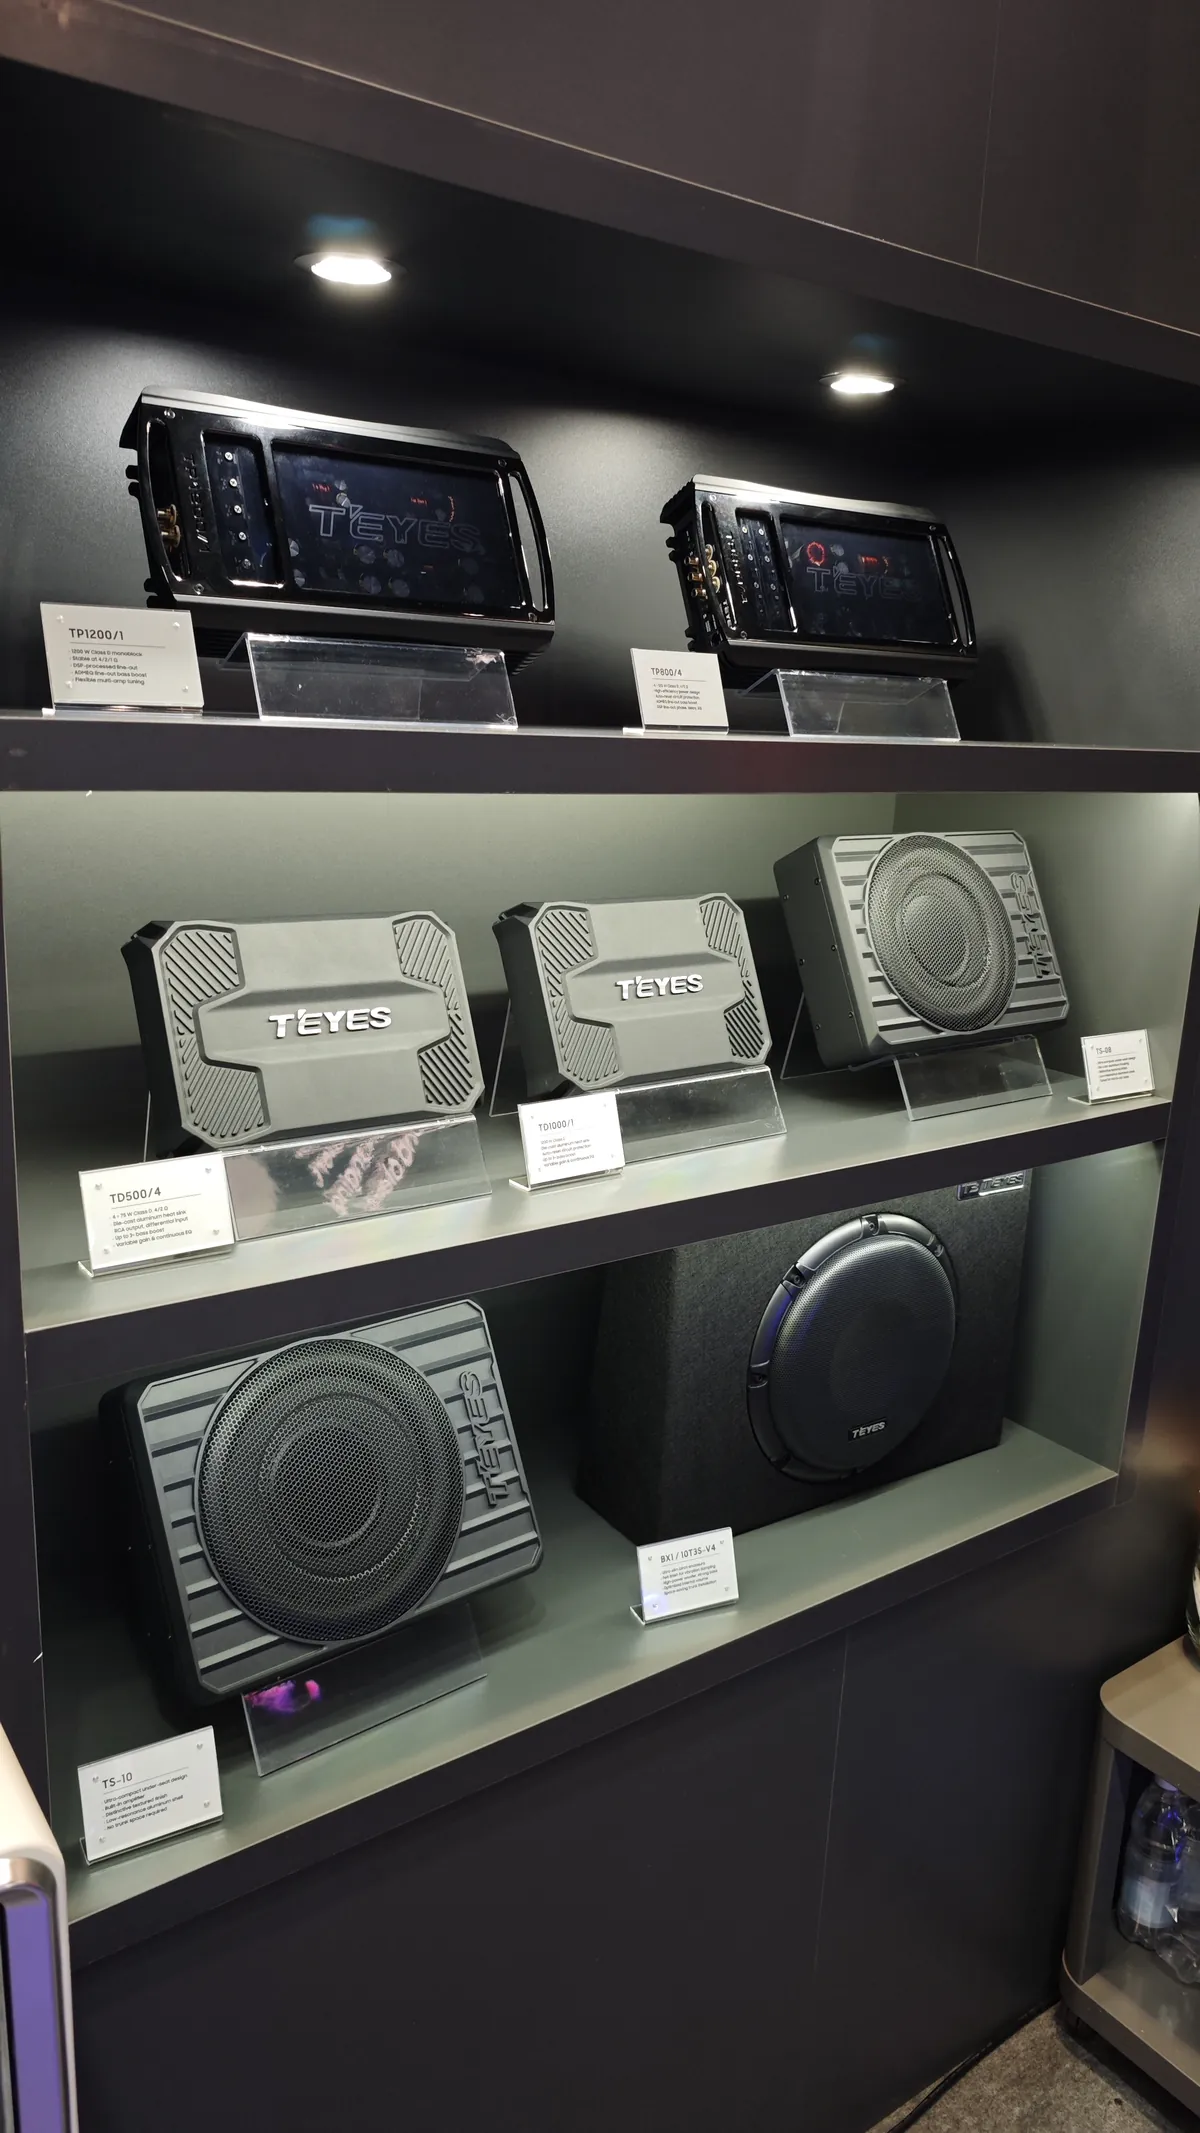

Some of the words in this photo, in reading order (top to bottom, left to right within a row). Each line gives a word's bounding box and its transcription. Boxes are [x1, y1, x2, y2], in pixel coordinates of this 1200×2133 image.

[69, 628, 124, 640] TP1200/1
[651, 668, 682, 676] TP800/4
[538, 1119, 574, 1131] TD1000/1
[110, 1187, 161, 1203] TD500/4
[137, 1214, 162, 1222] aluminum
[146, 1219, 174, 1228] differential
[156, 1232, 184, 1240] continuous
[102, 1772, 132, 1789] TS-10
[104, 1789, 141, 1804] Ultra-compact
[142, 1780, 170, 1792] under-seat
[171, 1774, 187, 1782] design
[106, 1806, 131, 1817] Distinctive
[133, 1799, 154, 1808] textured
[106, 1808, 146, 1824] Low-resonance
[147, 1799, 171, 1810] aluminum
[130, 1815, 145, 1823] space
[146, 1807, 167, 1817] required
